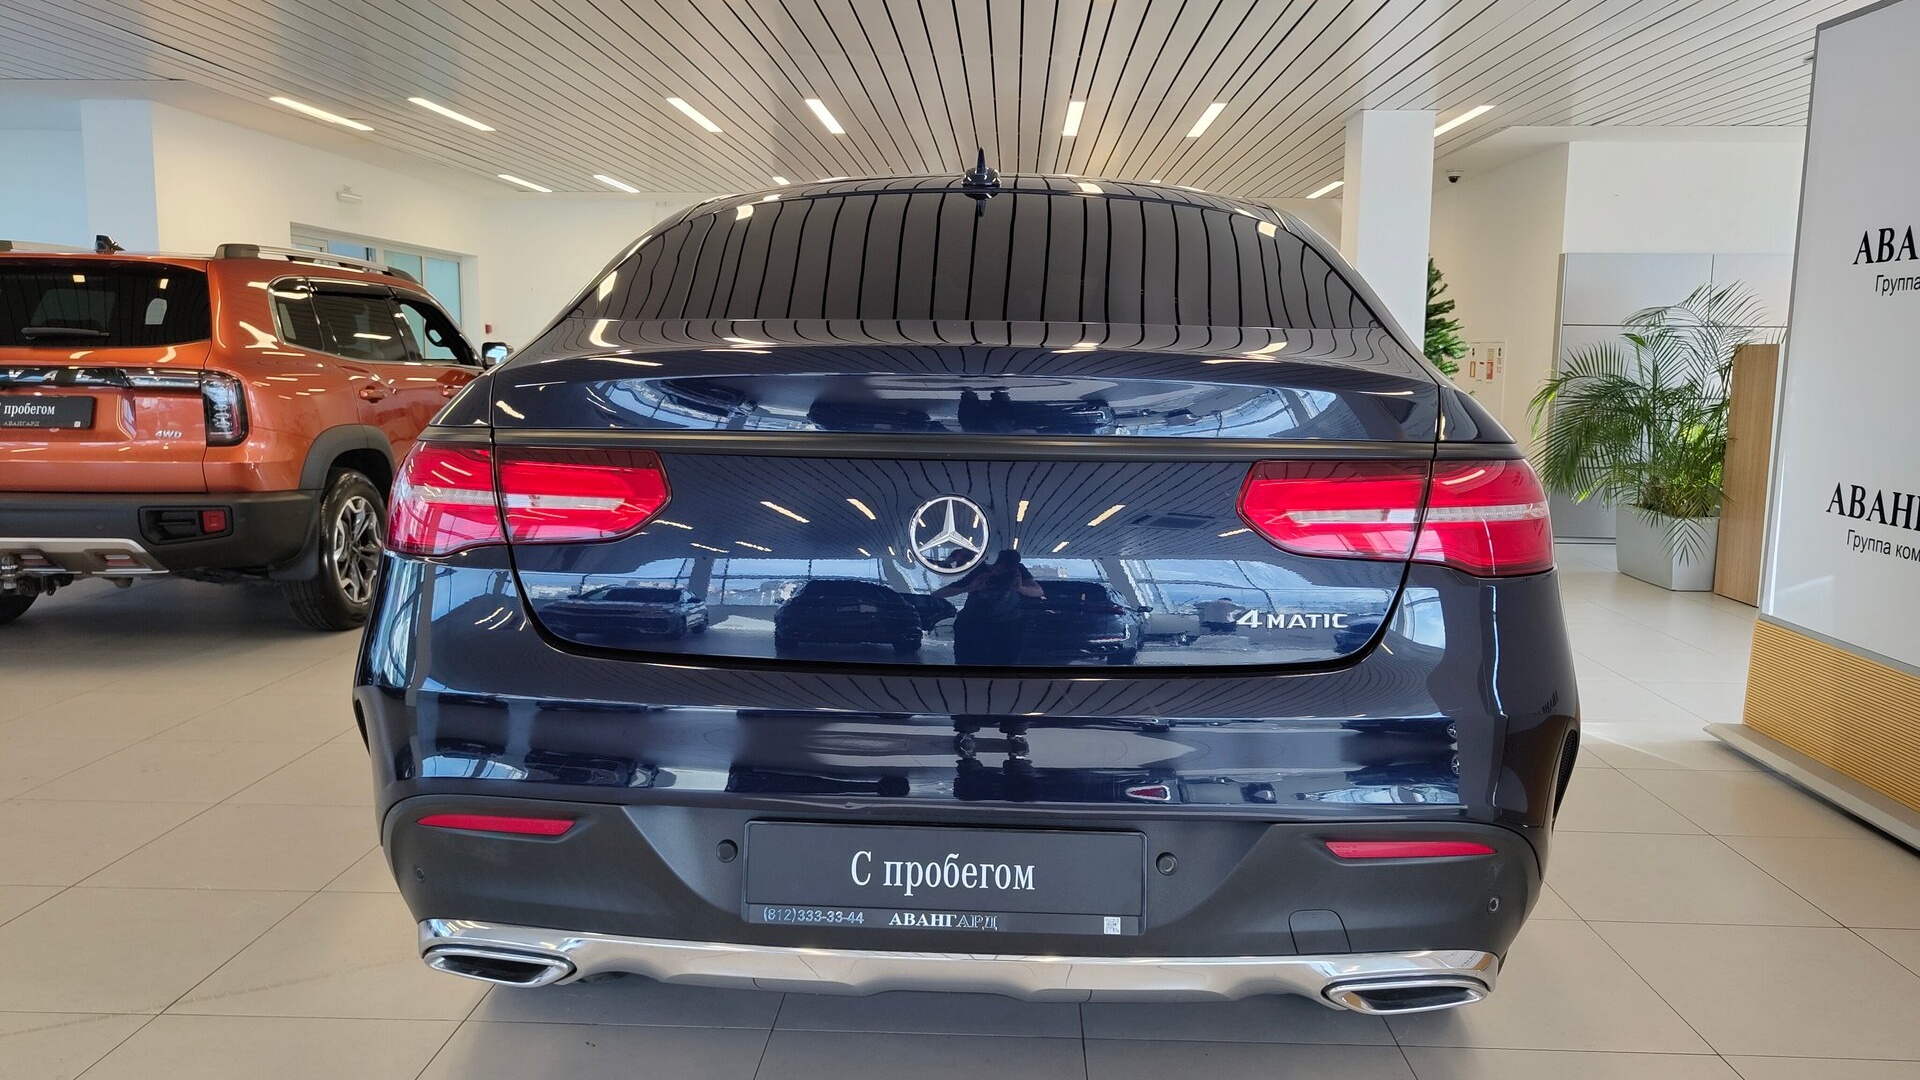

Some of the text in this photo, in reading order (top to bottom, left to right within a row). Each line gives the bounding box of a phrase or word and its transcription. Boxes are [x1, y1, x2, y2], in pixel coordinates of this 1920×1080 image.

[1853, 225, 1919, 265] АВА
[1875, 274, 1920, 297] Группа
[4, 402, 56, 418] пробегом
[155, 430, 182, 439] 4WD
[1846, 528, 1891, 555] Группа
[850, 850, 1036, 896] С пробегом
[763, 906, 865, 926] (812)333-33-44
[888, 912, 998, 931] АВАНГАРД
